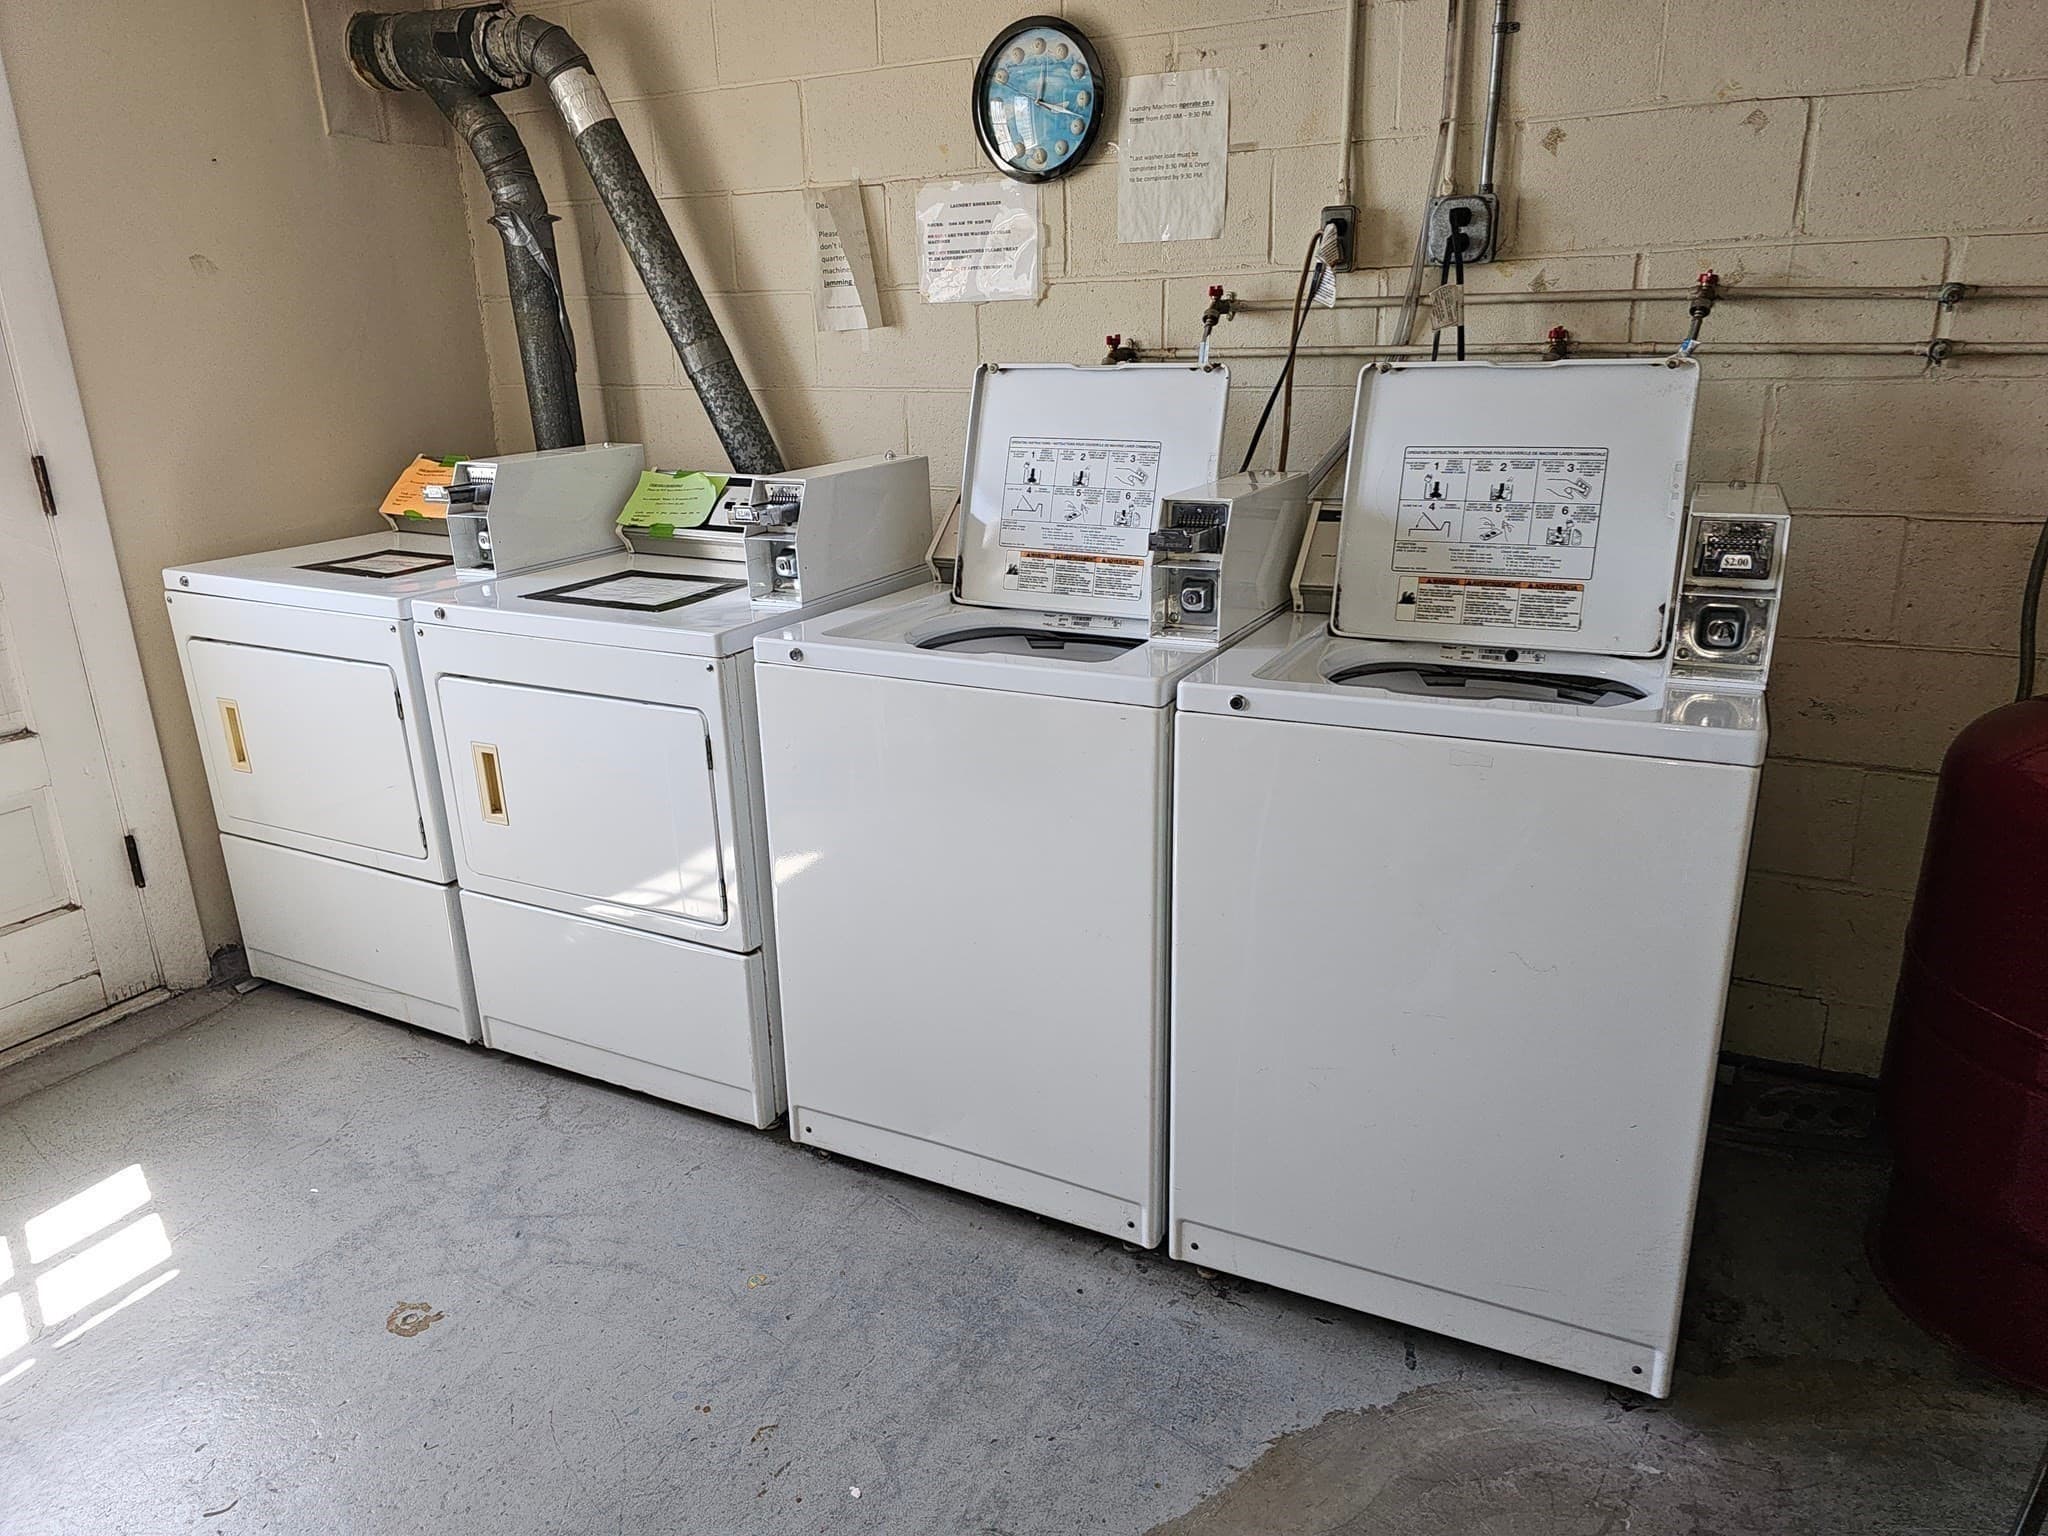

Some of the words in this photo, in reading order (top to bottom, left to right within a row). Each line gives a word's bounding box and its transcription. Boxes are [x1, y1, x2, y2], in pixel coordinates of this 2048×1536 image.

[820, 242, 837, 250] don't
[1080, 453, 1086, 461] 2
[1500, 463, 1507, 472] 2
[1567, 464, 1574, 472] 3
[1495, 504, 1502, 512] 5
[1562, 506, 1569, 515] 6
[1724, 556, 1749, 567] $2.00
